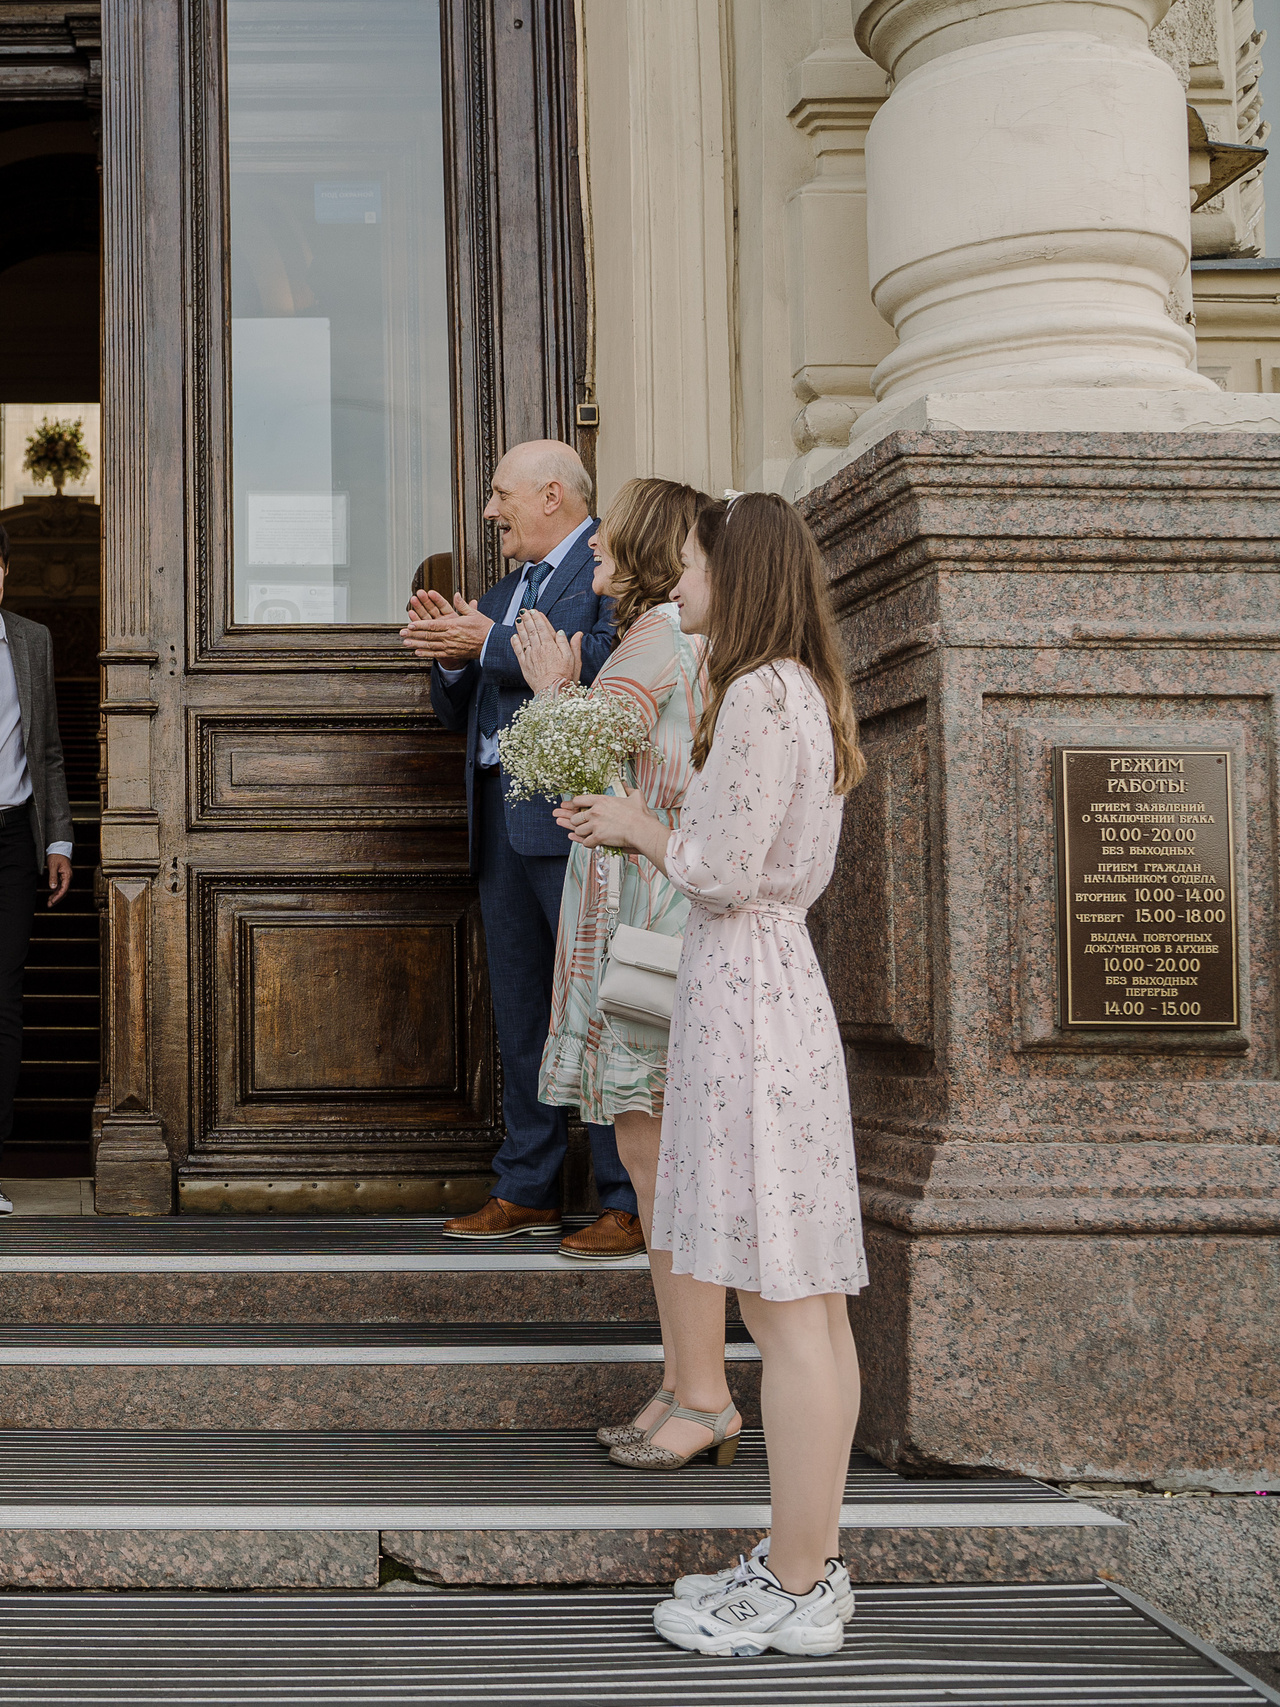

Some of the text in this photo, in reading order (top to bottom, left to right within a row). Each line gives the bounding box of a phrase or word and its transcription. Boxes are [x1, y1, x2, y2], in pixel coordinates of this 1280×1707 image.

[1110, 758, 1185, 773] РЕЖИМ
[1107, 778, 1189, 793] РАБОТЫ:
[1090, 802, 1205, 812] ПРИЕМ ЗАЯВЛЕНИЙ
[1082, 815, 1215, 823] О ЗАКЛЮЧЕНИИ БРАКА
[1102, 847, 1195, 856] БЕЗ ВЫХОДНЫХ
[1097, 863, 1201, 873] ПРИЕМ ГРАЖДАН
[1084, 875, 1216, 884] НАЧАЛЬНИКОМ ОТДЕЛА
[1075, 893, 1127, 902] ВТОРНИК
[1075, 914, 1125, 922] ЧЕТВЕРГ
[1090, 933, 1212, 943] ВЫДАЧА ПОВТОРНЫХ
[1084, 945, 1219, 954] ДОКУМЕНТОВ В АРХИВЕ
[1105, 977, 1198, 986] БЕЗ ВЫХОДНЫХ
[1125, 988, 1178, 997] ПЕРЕРЫВ
[728, 1599, 759, 1622] N
